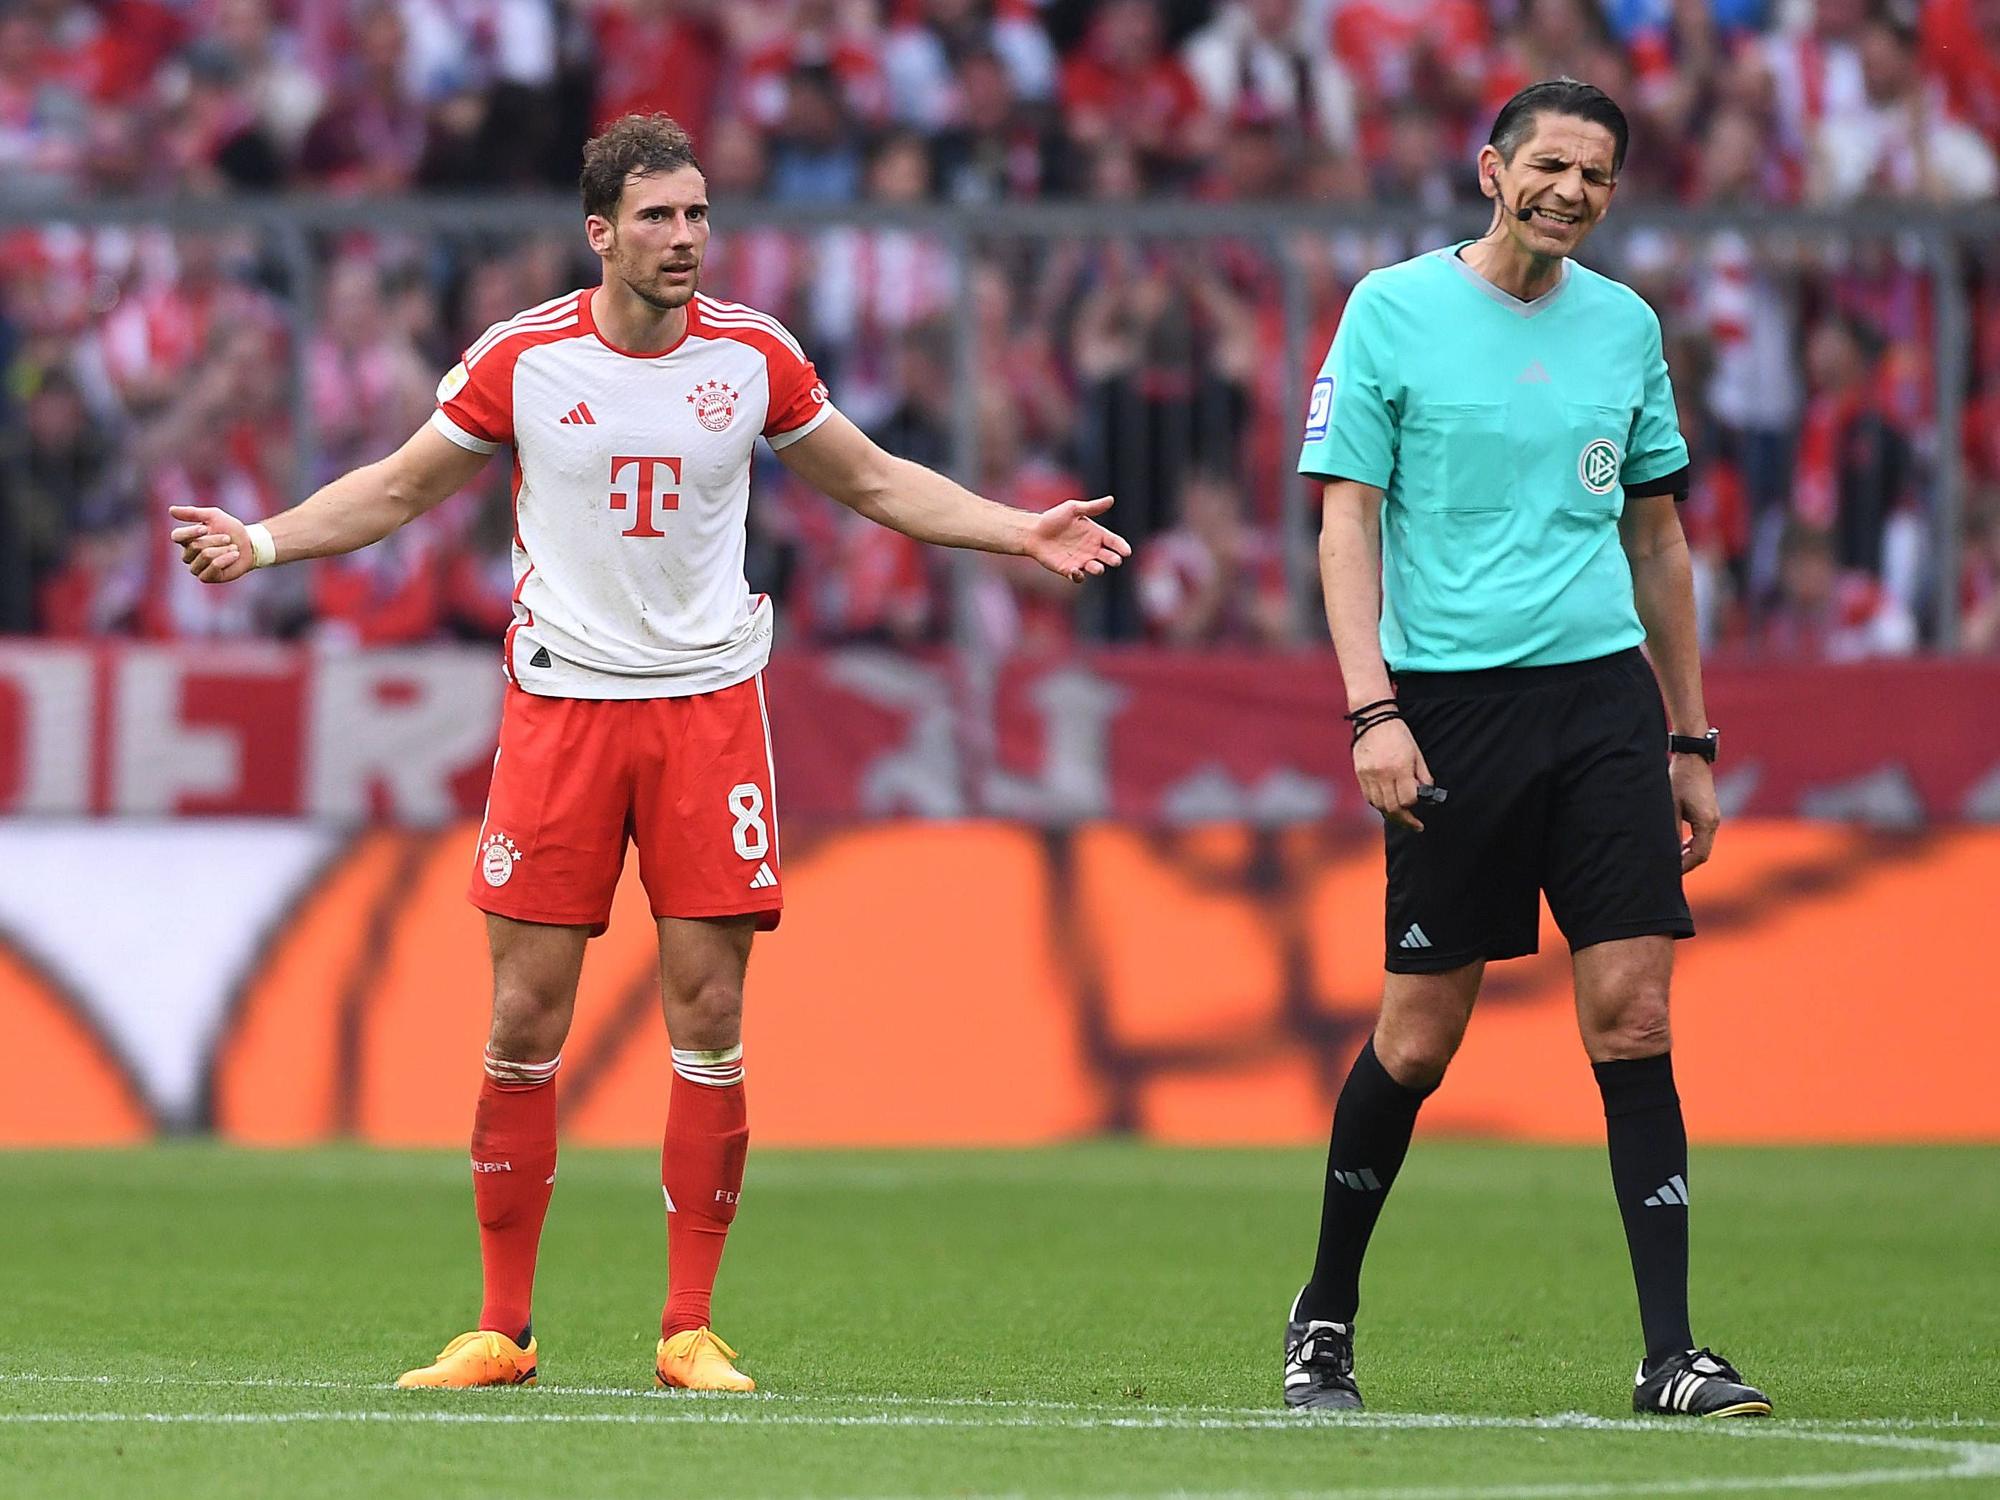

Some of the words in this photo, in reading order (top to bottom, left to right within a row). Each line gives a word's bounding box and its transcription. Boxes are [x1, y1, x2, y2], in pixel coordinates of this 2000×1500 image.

[609, 454, 682, 538] T
[727, 782, 769, 861] 8
[472, 1160, 512, 1174] ERN
